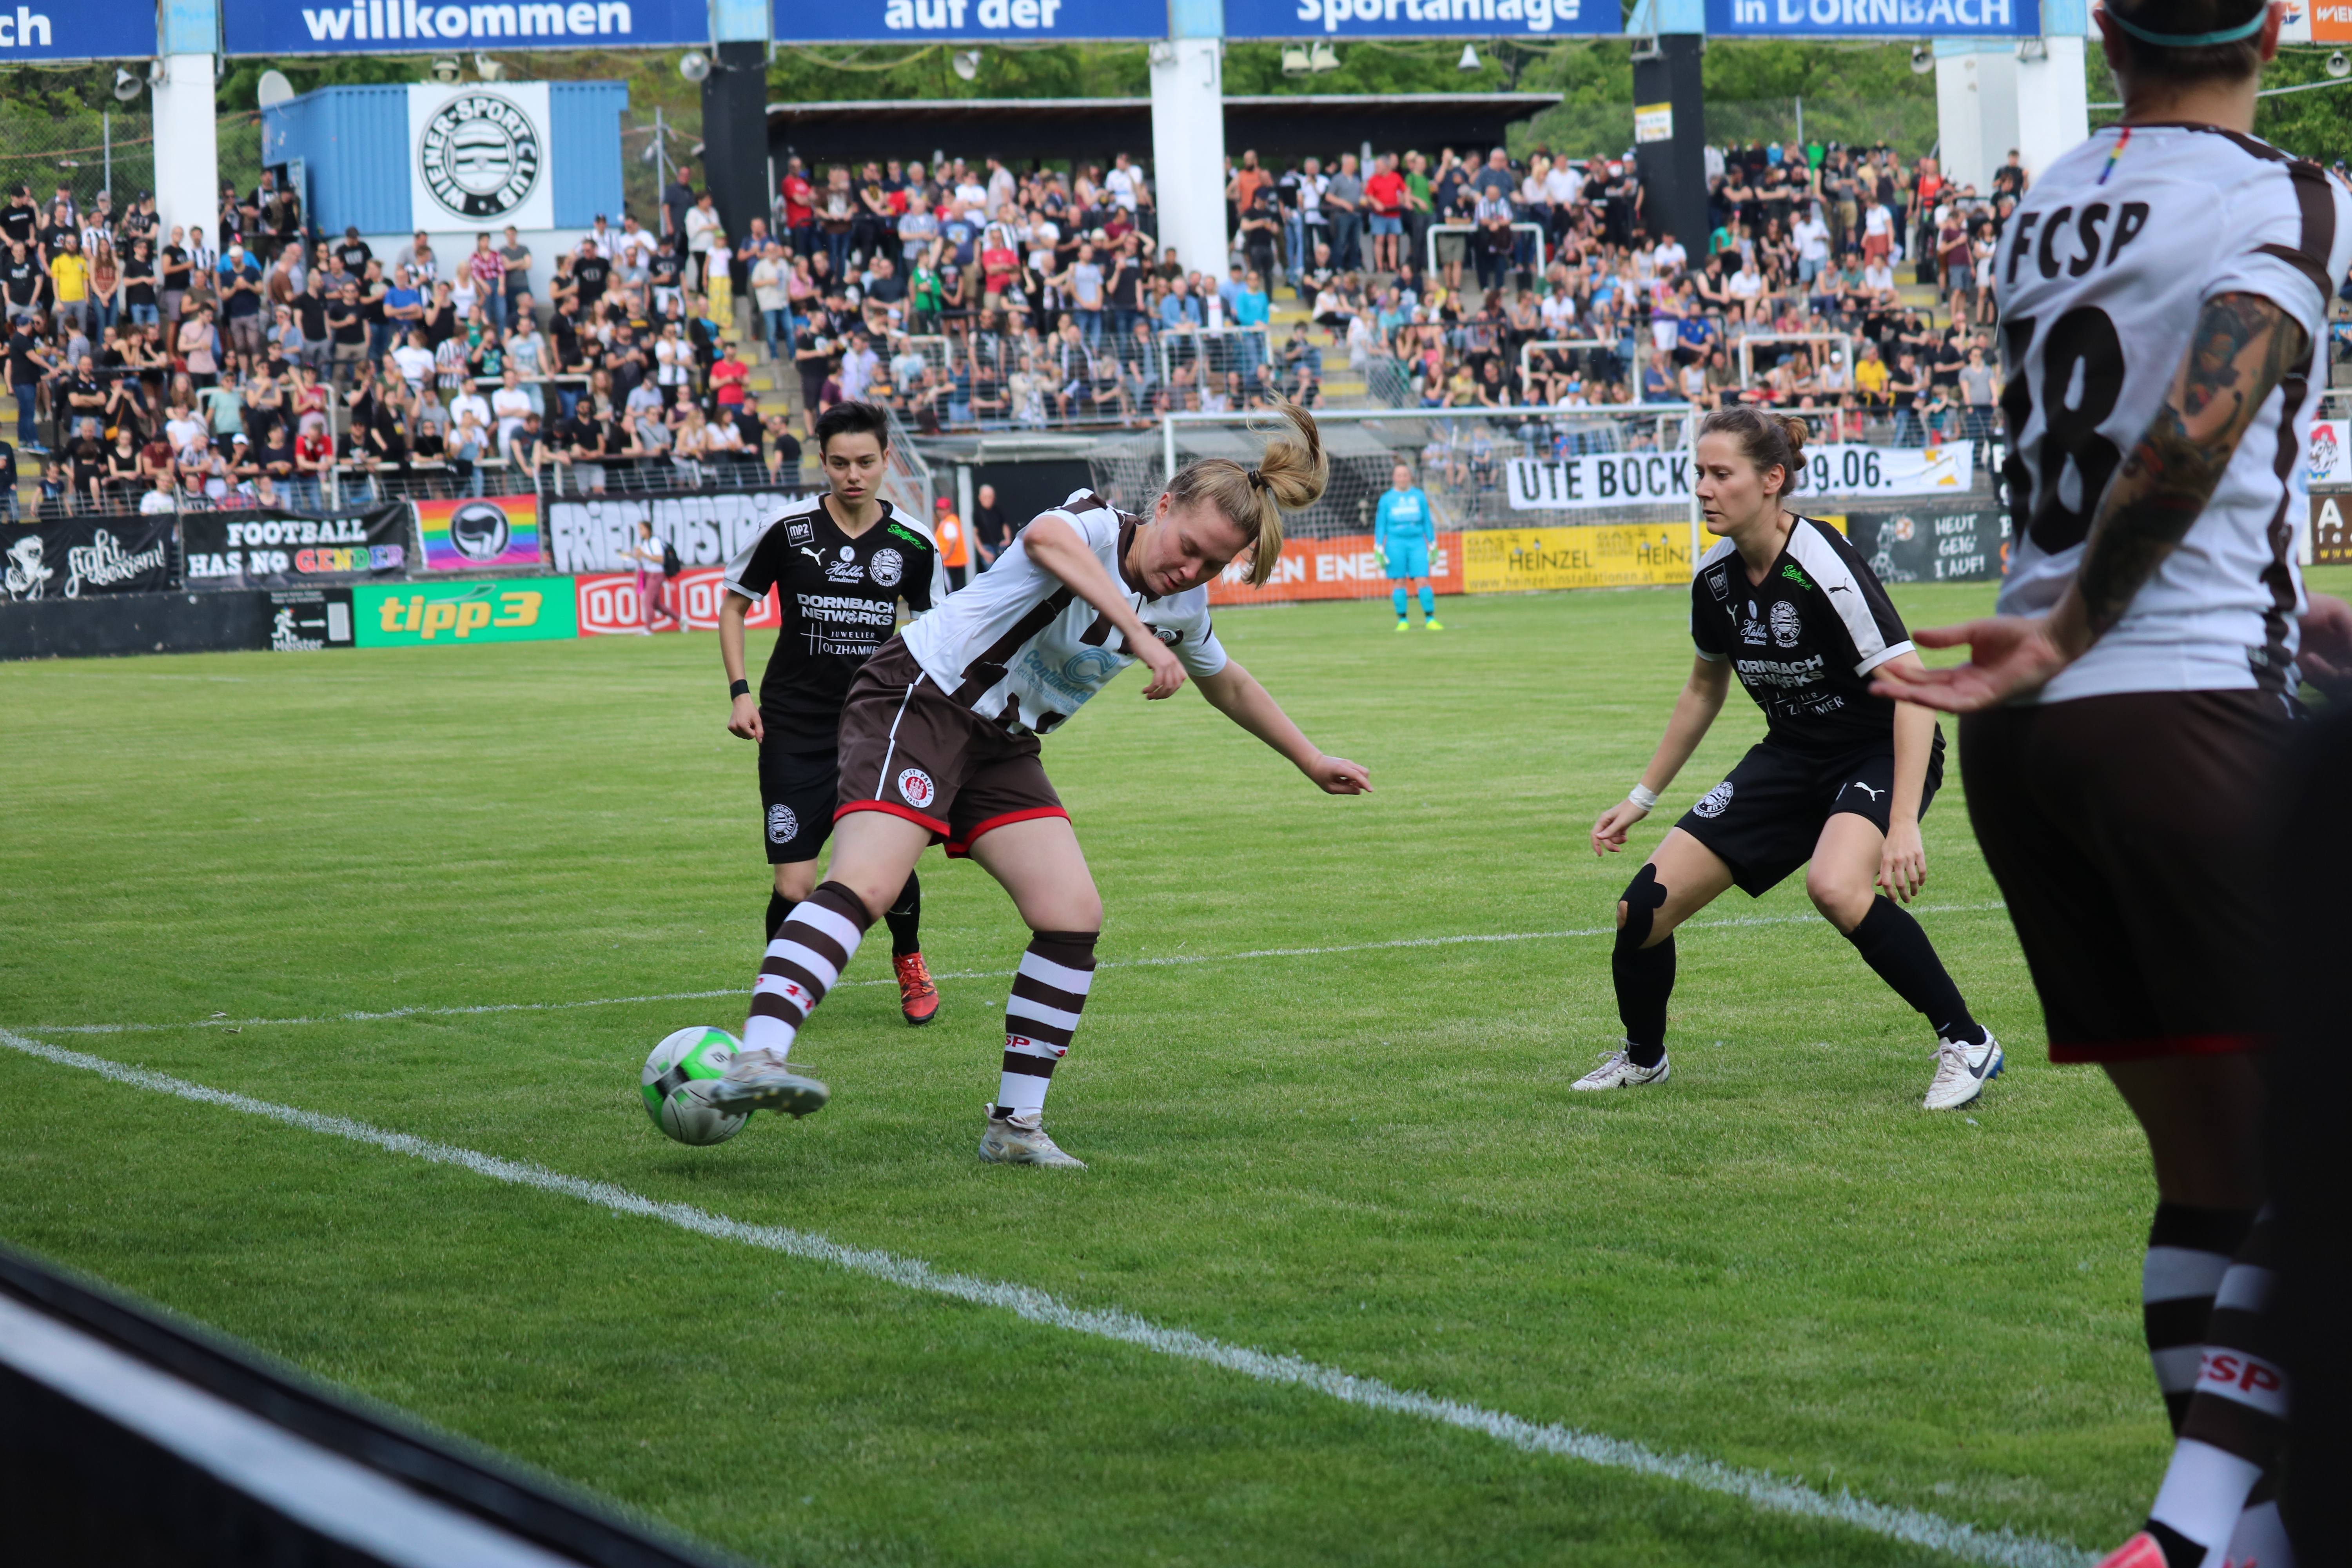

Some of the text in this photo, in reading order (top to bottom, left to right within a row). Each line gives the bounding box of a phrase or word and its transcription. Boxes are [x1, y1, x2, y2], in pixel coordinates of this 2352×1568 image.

[302, 0, 632, 40] willkommen
[884, 0, 1061, 29] auf der
[1297, 0, 1581, 32] Sportanlage
[1778, 0, 2010, 25] DORNBACH
[2007, 203, 2150, 285] FCSP
[1518, 460, 1583, 501] UTE
[1597, 456, 1689, 497] BOCK
[227, 518, 367, 547] FOOTBALL
[789, 523, 809, 537] MP2
[1935, 514, 1978, 536] HEUT
[65, 528, 126, 599] fight
[97, 539, 166, 586] sexism!
[188, 551, 243, 578] HAS
[295, 544, 405, 573] GENDER
[825, 561, 864, 578] Hübler
[1508, 550, 1594, 572] HEINZEL
[1948, 554, 1985, 577] AUF!
[828, 575, 859, 584] Konditorei
[875, 577, 896, 587] FRAUEN
[797, 593, 895, 614] DORNBACH
[273, 638, 325, 652] Meister
[1775, 639, 1798, 648] FRAUEN
[1023, 650, 1095, 705] Continental
[901, 772, 907, 780] FC
[920, 773, 933, 797] PAULI
[906, 795, 920, 806] 1910
